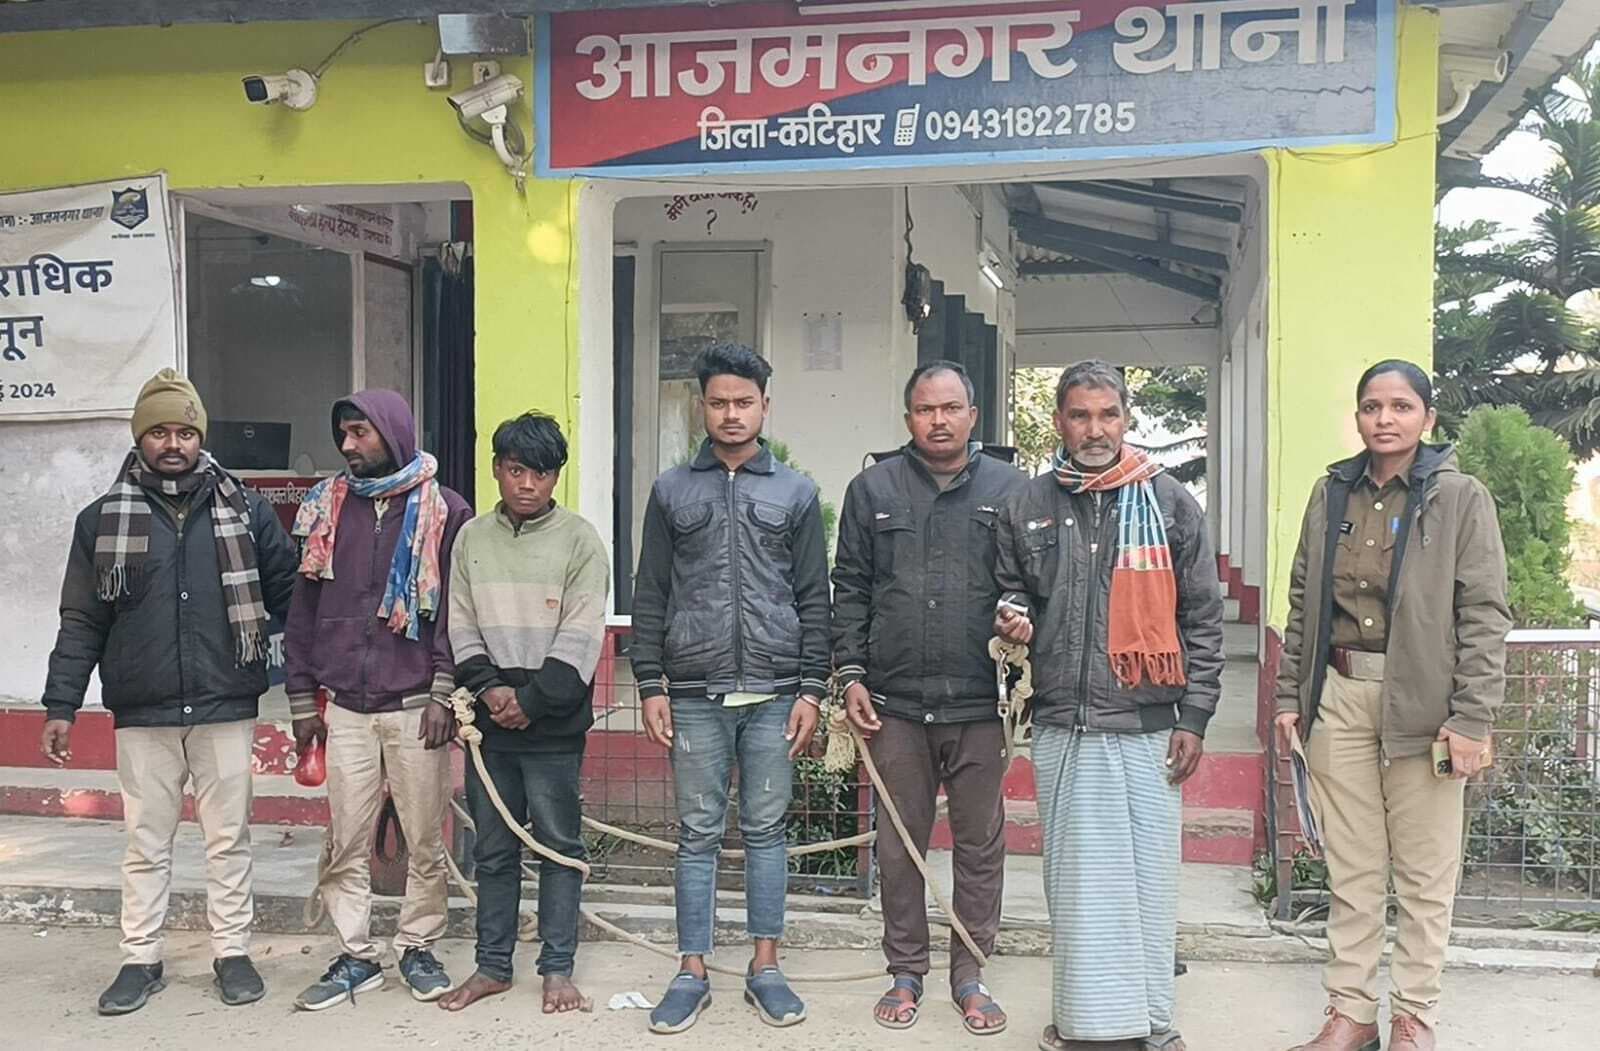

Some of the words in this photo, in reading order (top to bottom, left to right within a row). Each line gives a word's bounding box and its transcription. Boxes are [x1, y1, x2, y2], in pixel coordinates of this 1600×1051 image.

[575, 10, 1081, 101] आजमनगर
[1112, 0, 1349, 75] थाना
[697, 102, 885, 154] जिला-कटिहार
[925, 102, 1136, 140] 09431822785
[29, 209, 80, 225] आजमनगर
[10, 383, 56, 399] 2024
